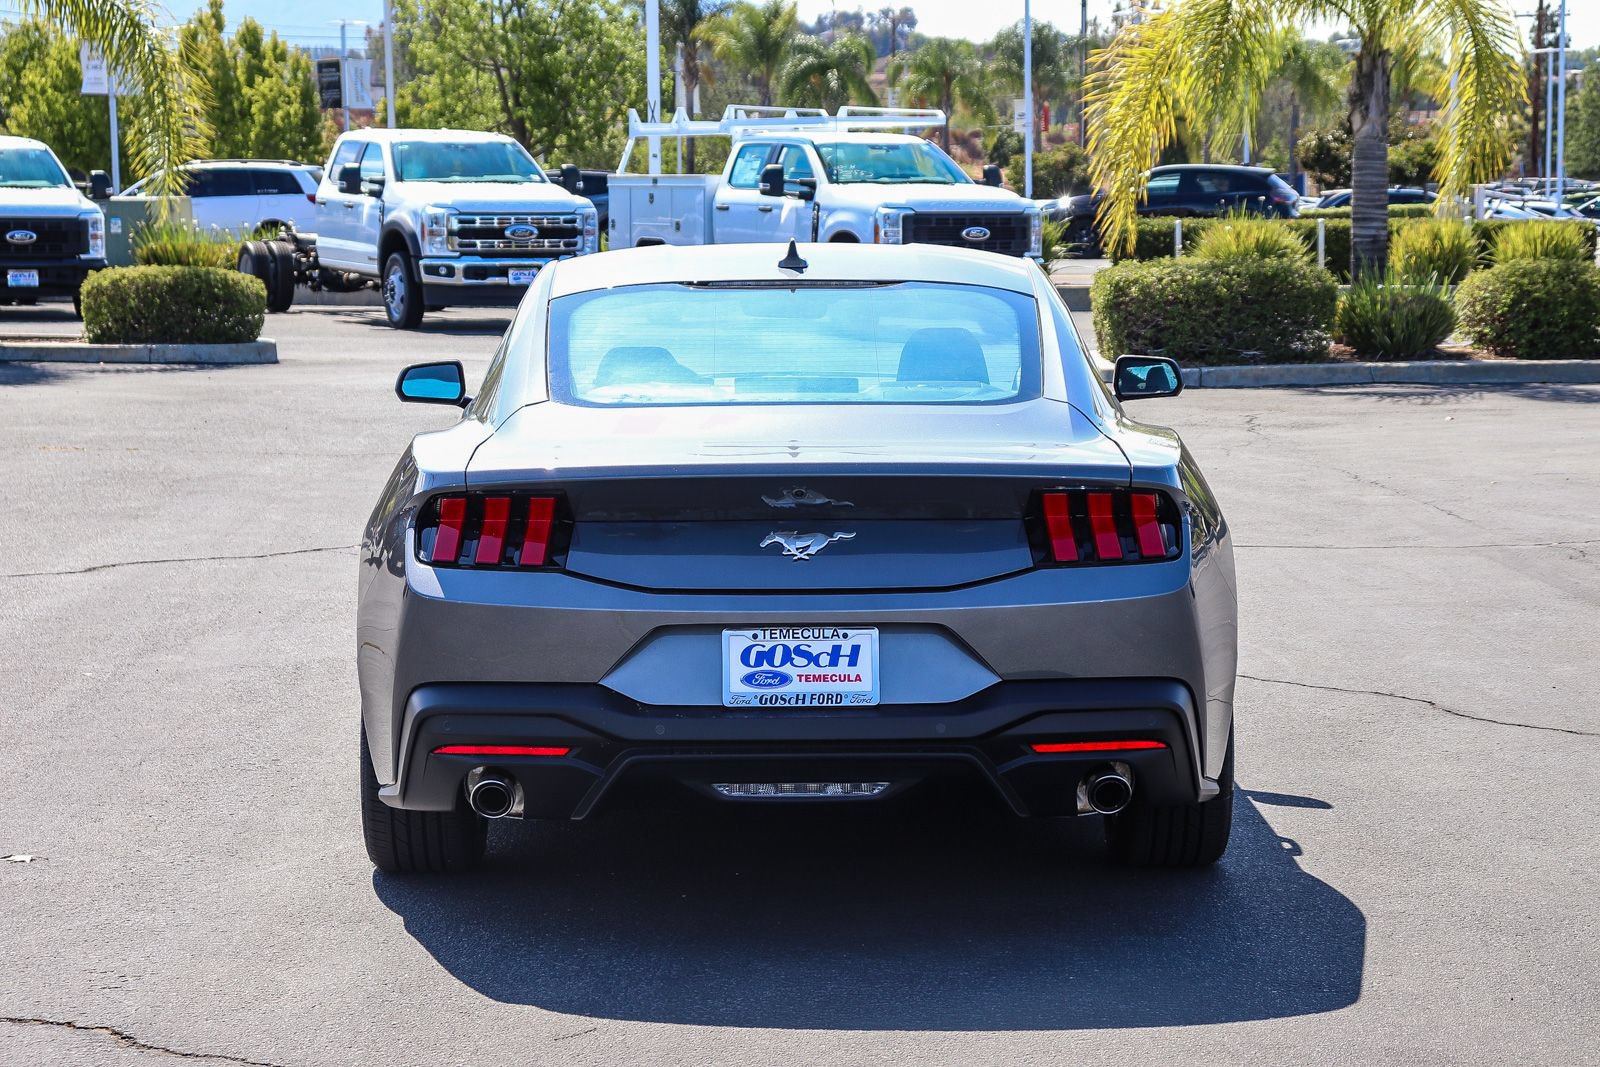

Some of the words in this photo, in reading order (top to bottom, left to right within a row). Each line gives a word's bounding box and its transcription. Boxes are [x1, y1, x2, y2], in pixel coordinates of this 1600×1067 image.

[760, 628, 840, 640] TEMECULA
[752, 673, 780, 686] Ford
[797, 674, 862, 683] TEMECULA
[729, 695, 753, 705] Ford
[810, 693, 843, 705] FORD
[849, 694, 873, 704] Ford
